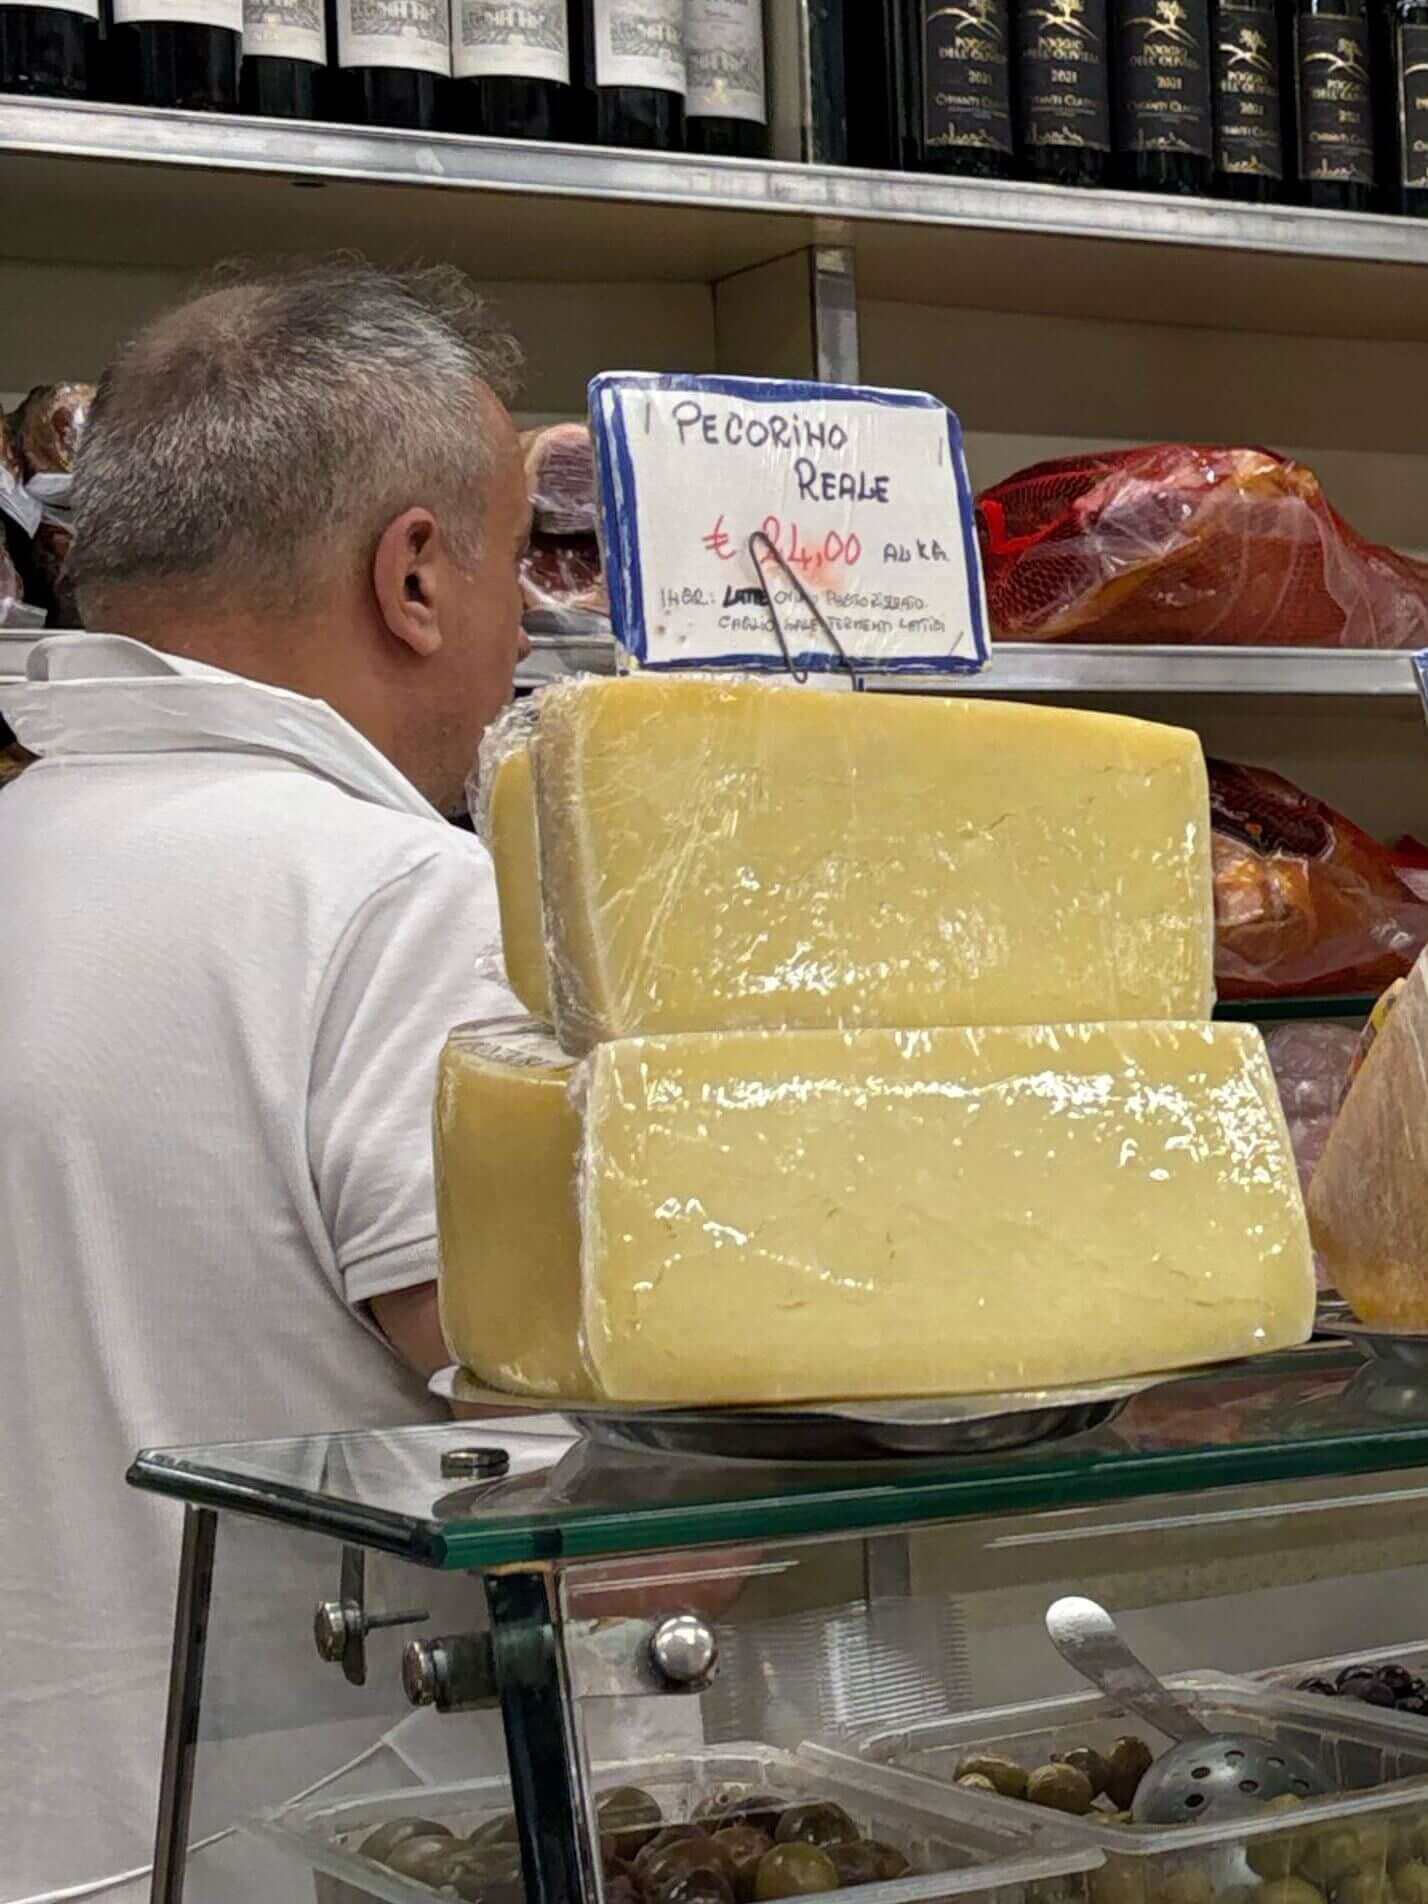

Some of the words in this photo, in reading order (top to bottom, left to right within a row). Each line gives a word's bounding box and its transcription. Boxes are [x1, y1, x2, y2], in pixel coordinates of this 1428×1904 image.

[672, 400, 848, 450] PECORINO
[794, 458, 891, 503] REALE
[703, 515, 736, 560] €
[760, 515, 863, 568] 24,00
